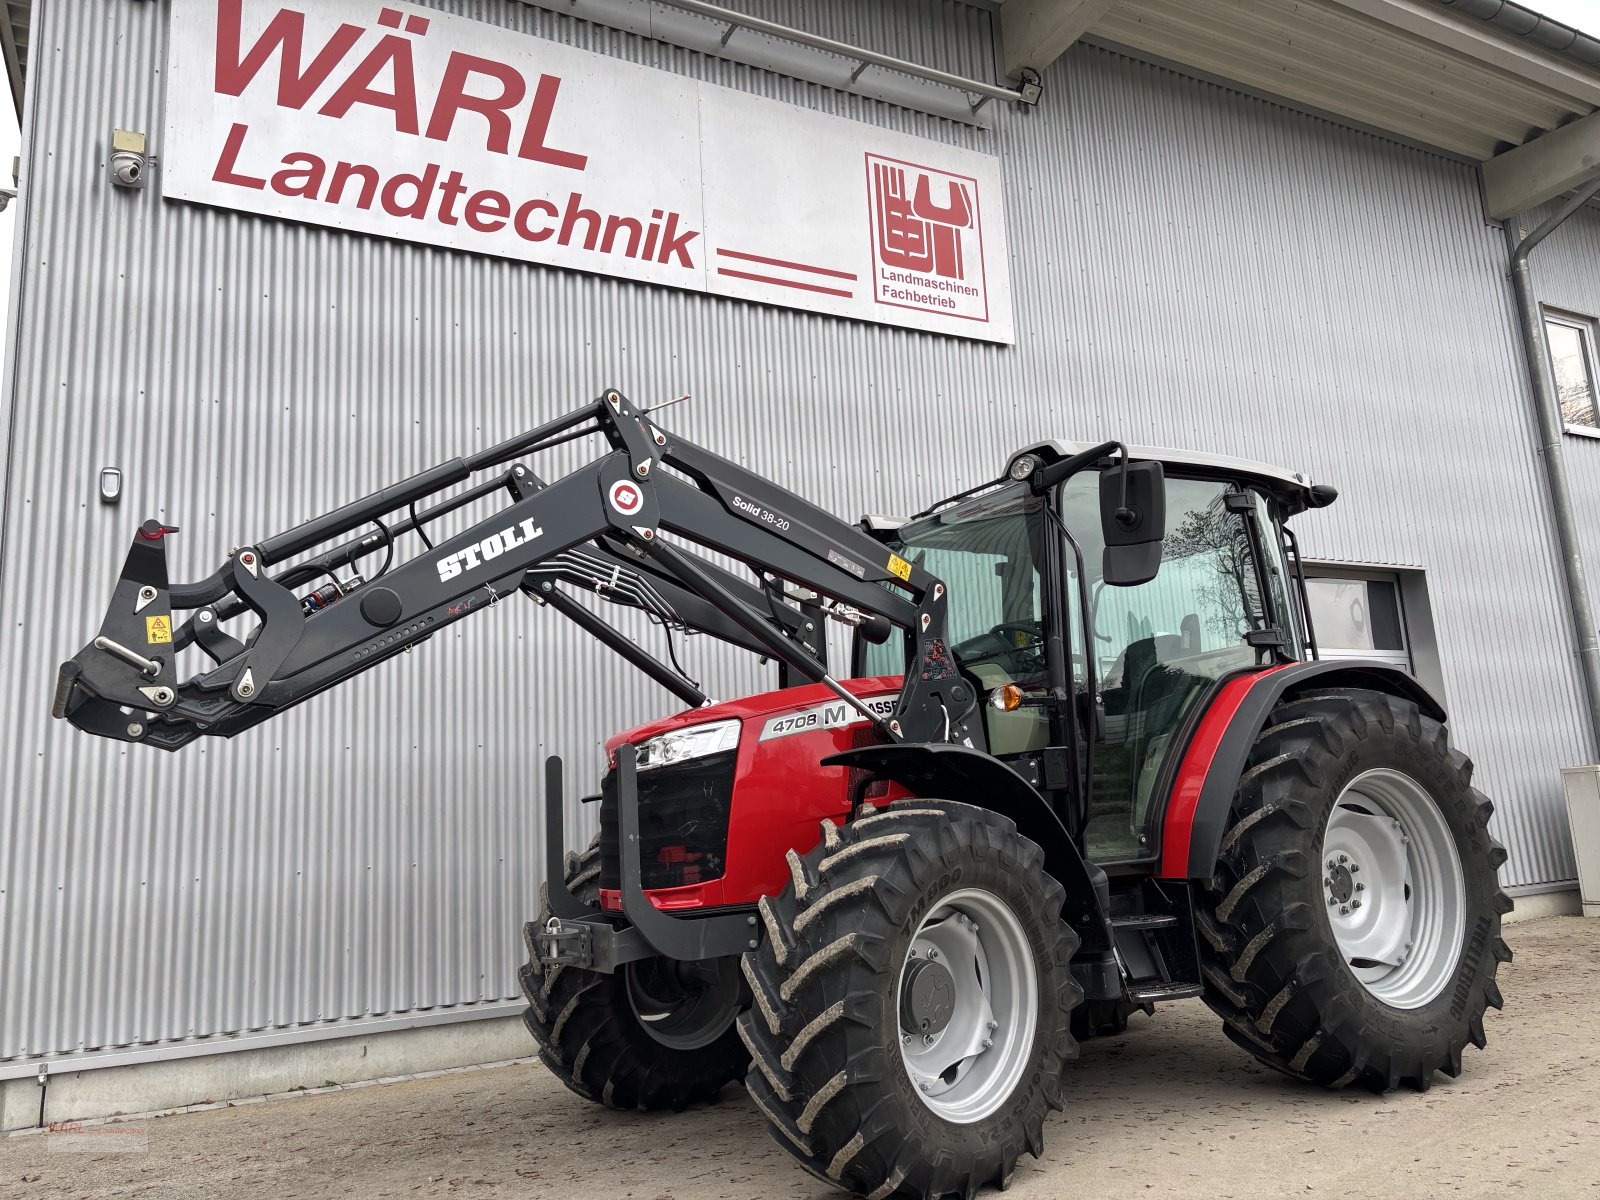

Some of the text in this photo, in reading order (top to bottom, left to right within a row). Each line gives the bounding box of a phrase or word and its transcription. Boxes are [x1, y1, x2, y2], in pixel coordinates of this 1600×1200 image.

[214, 0, 587, 171] WÄRL
[211, 123, 701, 270] Landtechnik
[881, 267, 979, 297] Landmaschinen
[882, 284, 956, 309] Fachbetrieb
[732, 496, 790, 532] Solid 38-20
[436, 517, 543, 583] STOLL
[772, 714, 817, 733] 4708
[824, 705, 846, 725] M
[1449, 915, 1492, 1022] TRELLEBORG
